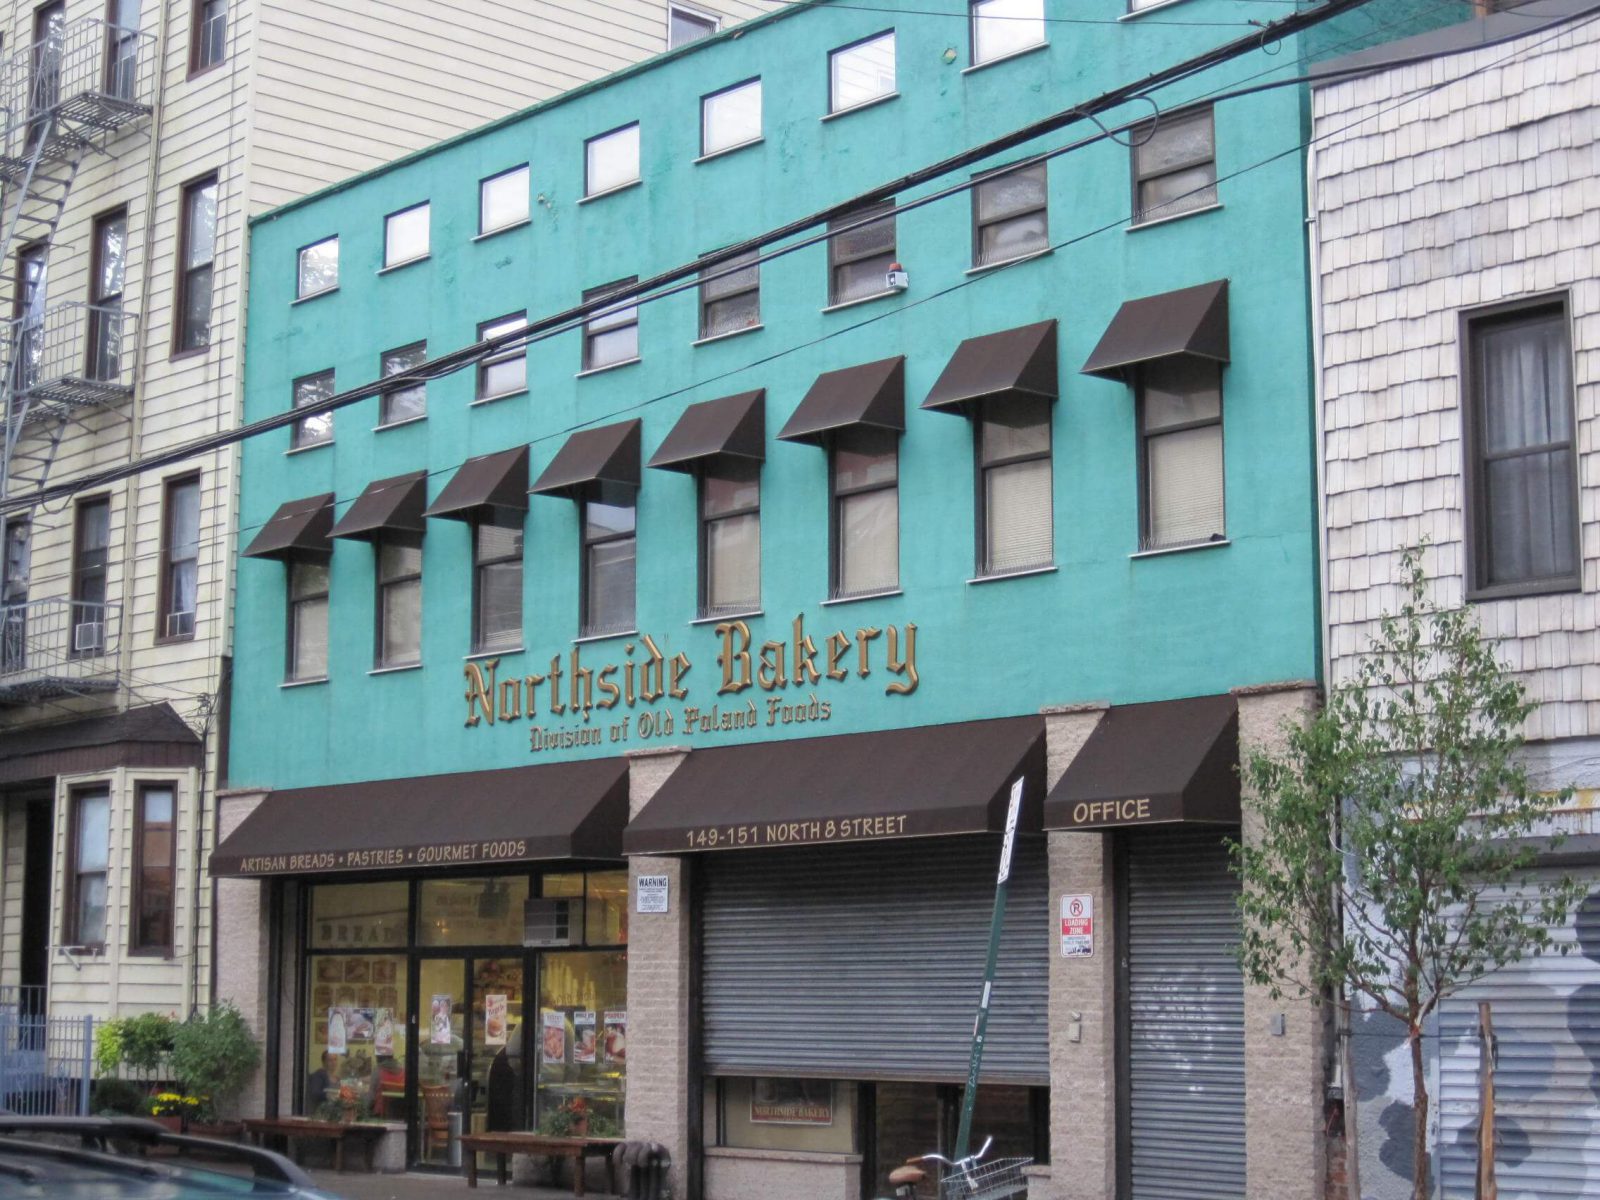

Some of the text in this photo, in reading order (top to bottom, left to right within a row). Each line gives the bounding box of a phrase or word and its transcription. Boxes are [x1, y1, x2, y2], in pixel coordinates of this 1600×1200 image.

[464, 611, 919, 728] Northside Bakery
[530, 693, 832, 752] Division of Old Poland Foods
[1073, 799, 1151, 823] OFFICE
[686, 815, 907, 848] 149-151 NORTH 8 STREET
[240, 840, 527, 873] ARTISAN BREADS PASTRIES GOURMET FOODS
[638, 877, 667, 888] WARNING
[1064, 918, 1089, 927] LOADING
[1069, 926, 1084, 935] ZONE
